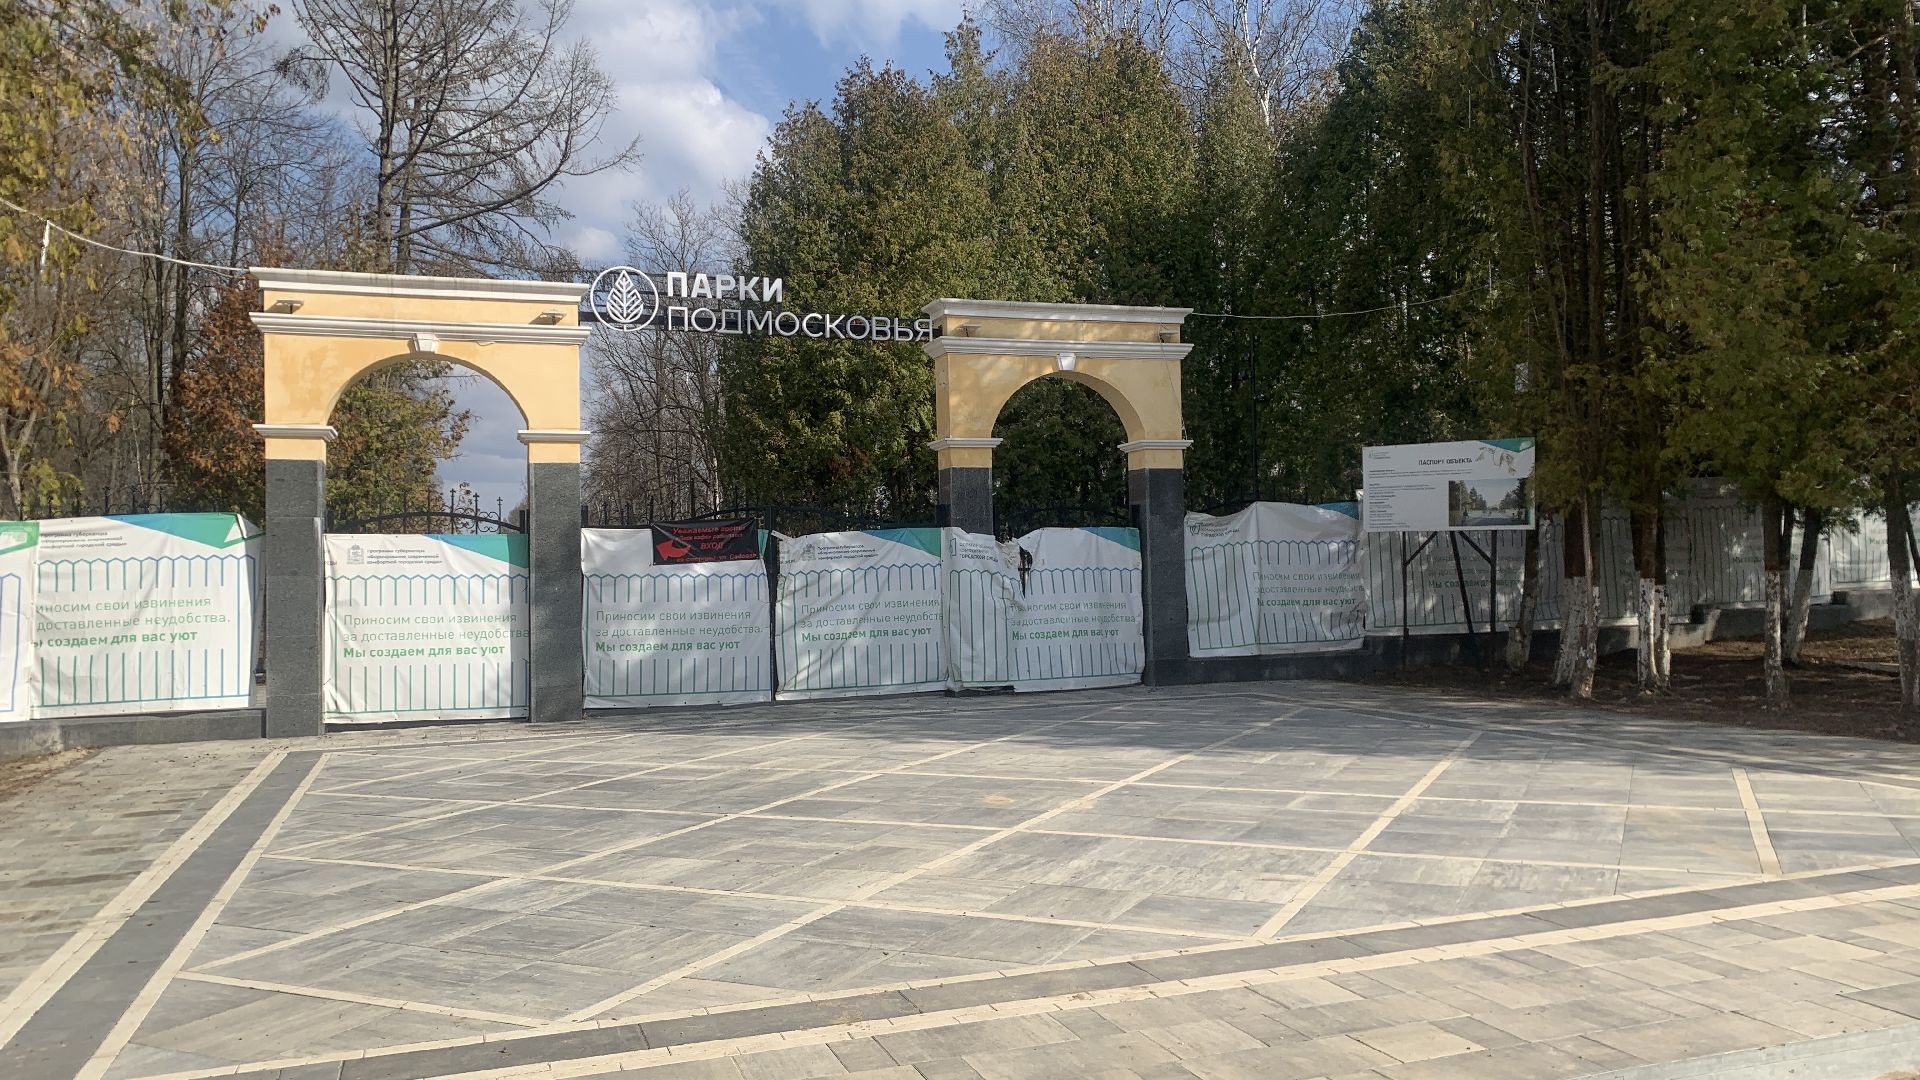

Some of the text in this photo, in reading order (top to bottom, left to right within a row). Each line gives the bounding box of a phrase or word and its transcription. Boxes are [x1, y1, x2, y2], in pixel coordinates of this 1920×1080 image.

[667, 271, 783, 303] ПАРКИ
[668, 306, 933, 342] ПОДМОСКОВЬЯ
[1446, 457, 1473, 465] ОБЪЕКТА
[700, 542, 724, 550] ВХОД
[1292, 572, 1315, 581] свои
[95, 600, 130, 611] свои
[134, 597, 212, 609] извинения
[801, 599, 941, 617] Приносим свои извинения
[1060, 602, 1081, 611] свои
[1266, 598, 1300, 607] создаем
[1302, 597, 1321, 608] для
[1322, 597, 1338, 606] вас
[1338, 597, 1356, 607] уют
[36, 611, 231, 633] доставленные неудобства.
[343, 613, 518, 627] Приносим свои извинения
[596, 610, 751, 623] Приносим свои извинения
[800, 620, 813, 629] за
[815, 613, 892, 629] доставленные
[47, 636, 108, 648] создаем
[110, 633, 137, 646] для
[141, 631, 167, 643] вас
[169, 630, 198, 642] уют
[343, 632, 357, 642] за
[360, 629, 455, 643] доставленные
[595, 628, 609, 637] за
[611, 626, 696, 638] доставленные
[801, 626, 932, 643] Мы создаем для вас уют
[1011, 630, 1027, 641] Мы
[1029, 629, 1070, 641] создаем
[1071, 628, 1089, 639] для
[1103, 628, 1120, 638] уют
[343, 645, 505, 659] Мы создаем для вас уют
[595, 640, 741, 653] Мы создаем для вас уют
